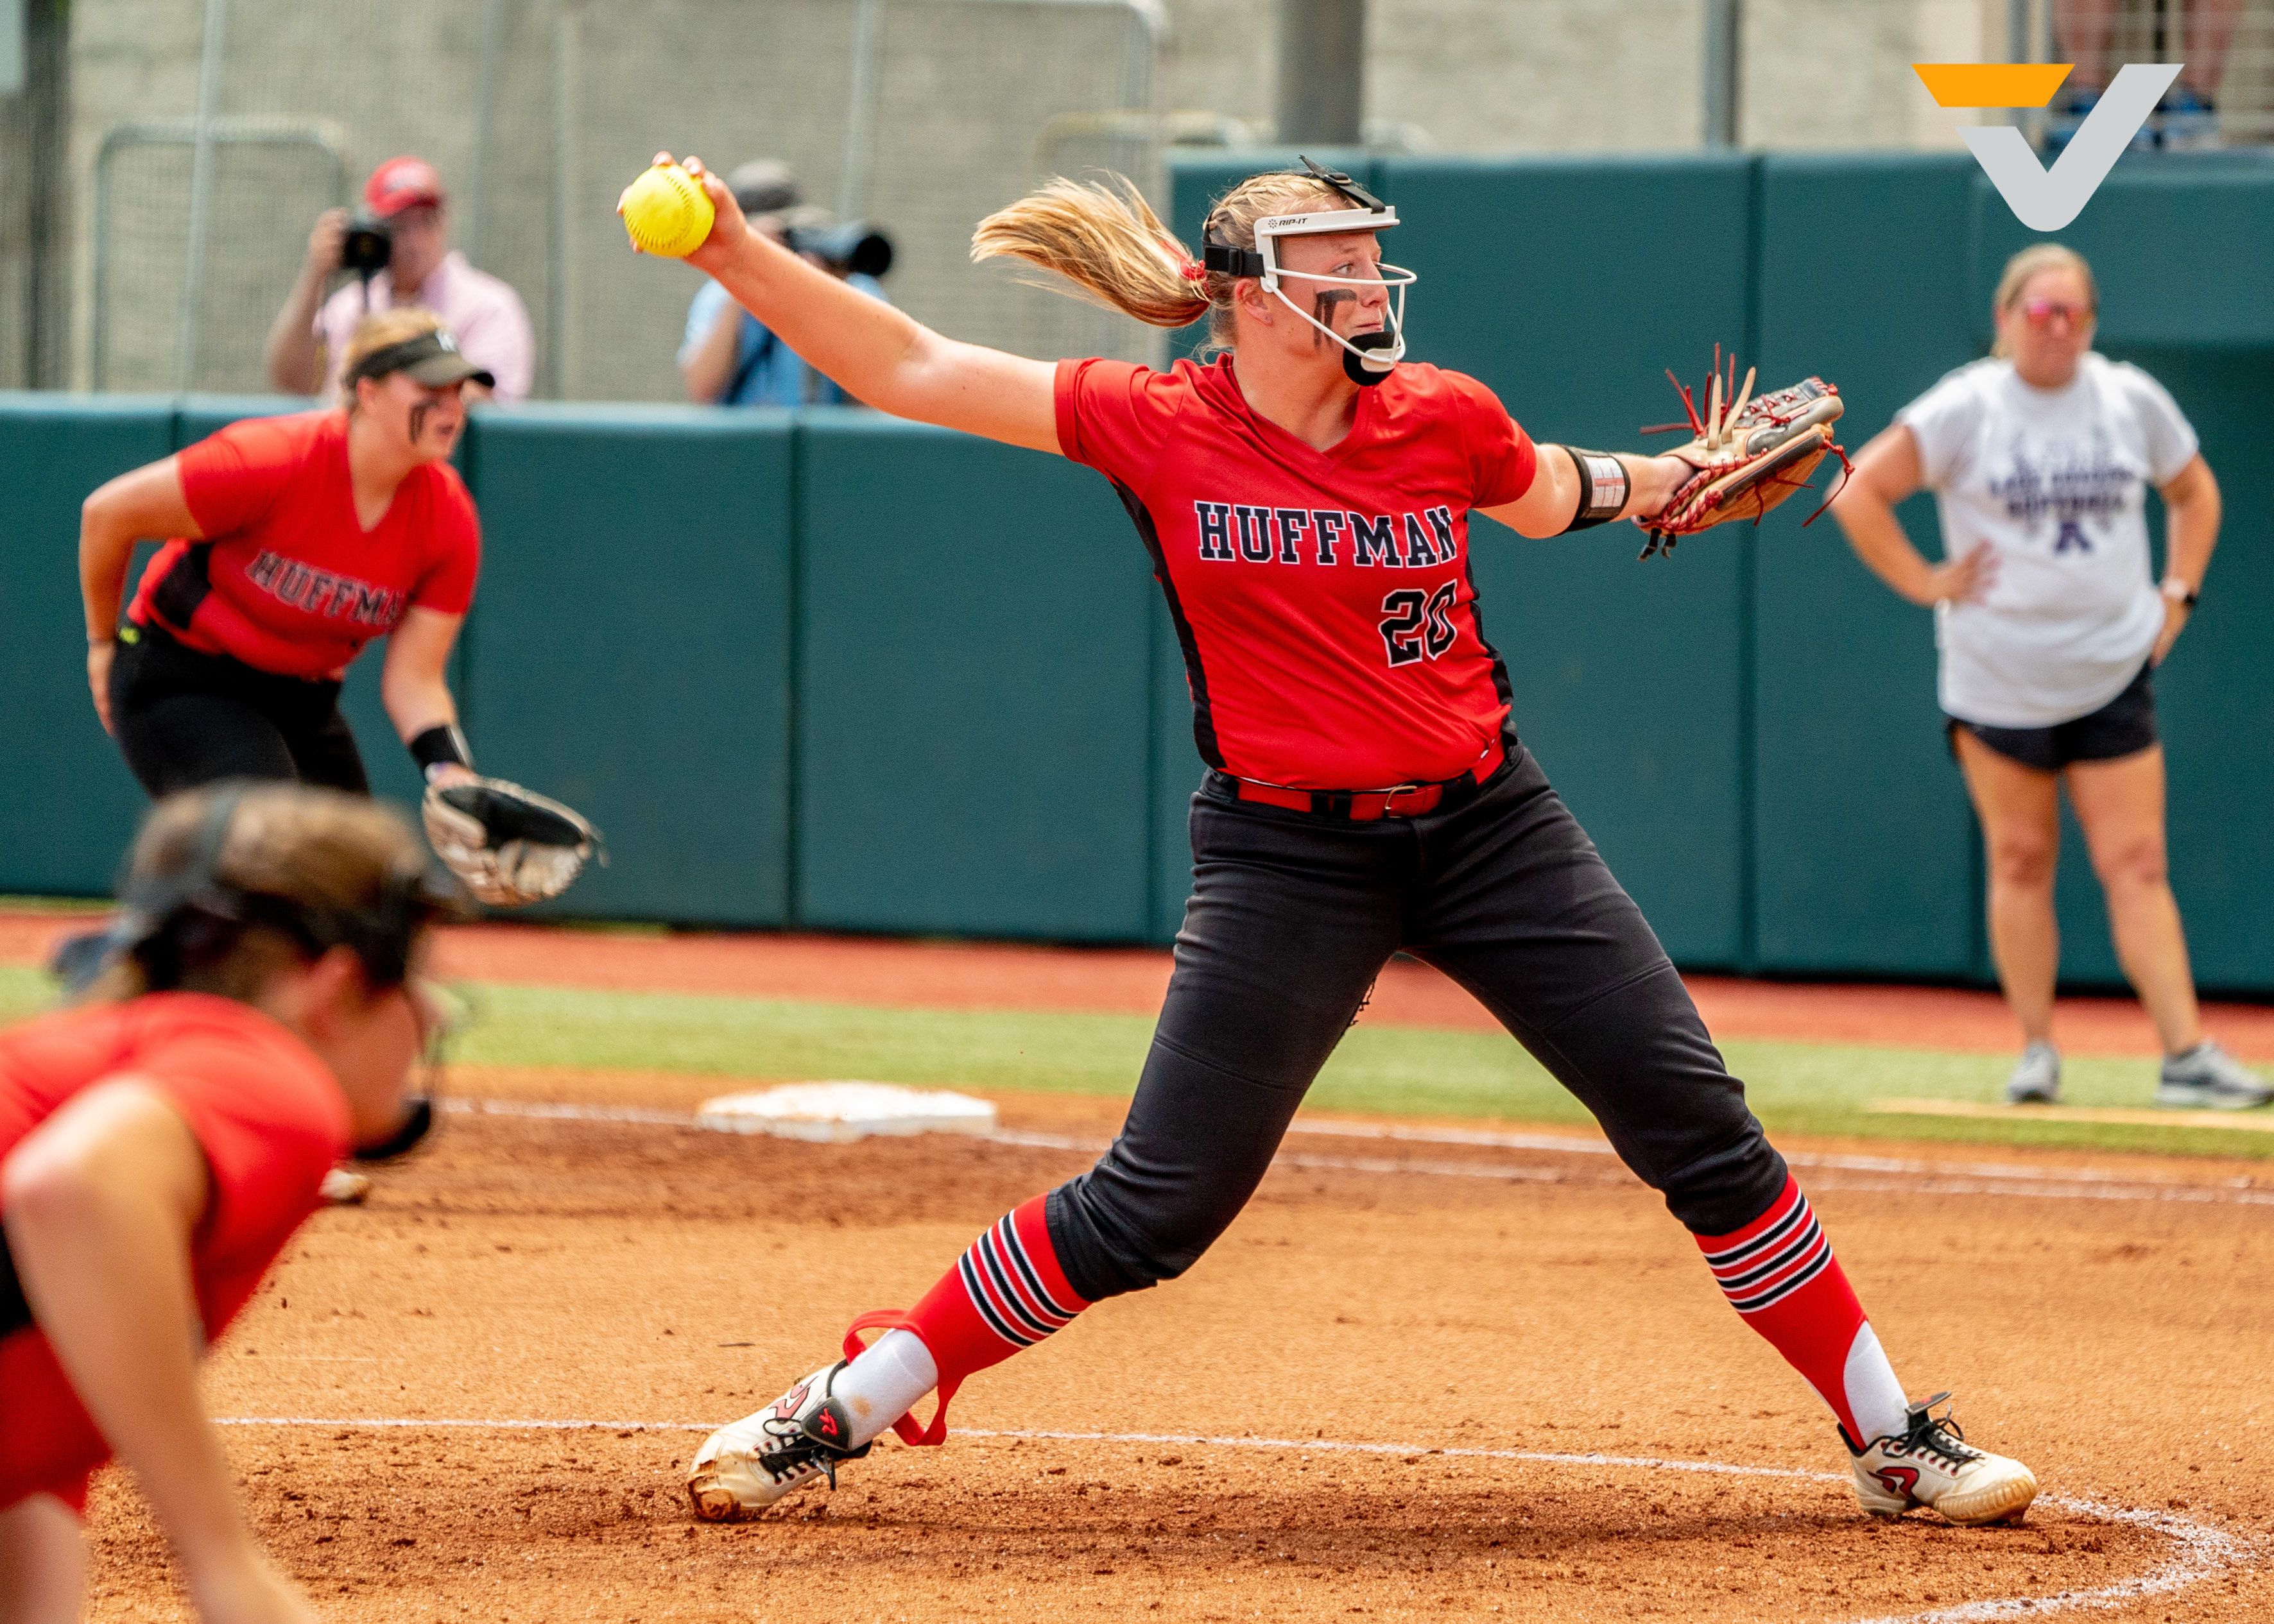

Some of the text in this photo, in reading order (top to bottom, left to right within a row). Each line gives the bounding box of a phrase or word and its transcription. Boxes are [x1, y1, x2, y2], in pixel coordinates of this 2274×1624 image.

[1279, 218, 1308, 227] RIP-IT
[1194, 500, 1458, 568] HUFFMAN
[1379, 578, 1458, 668] 20
